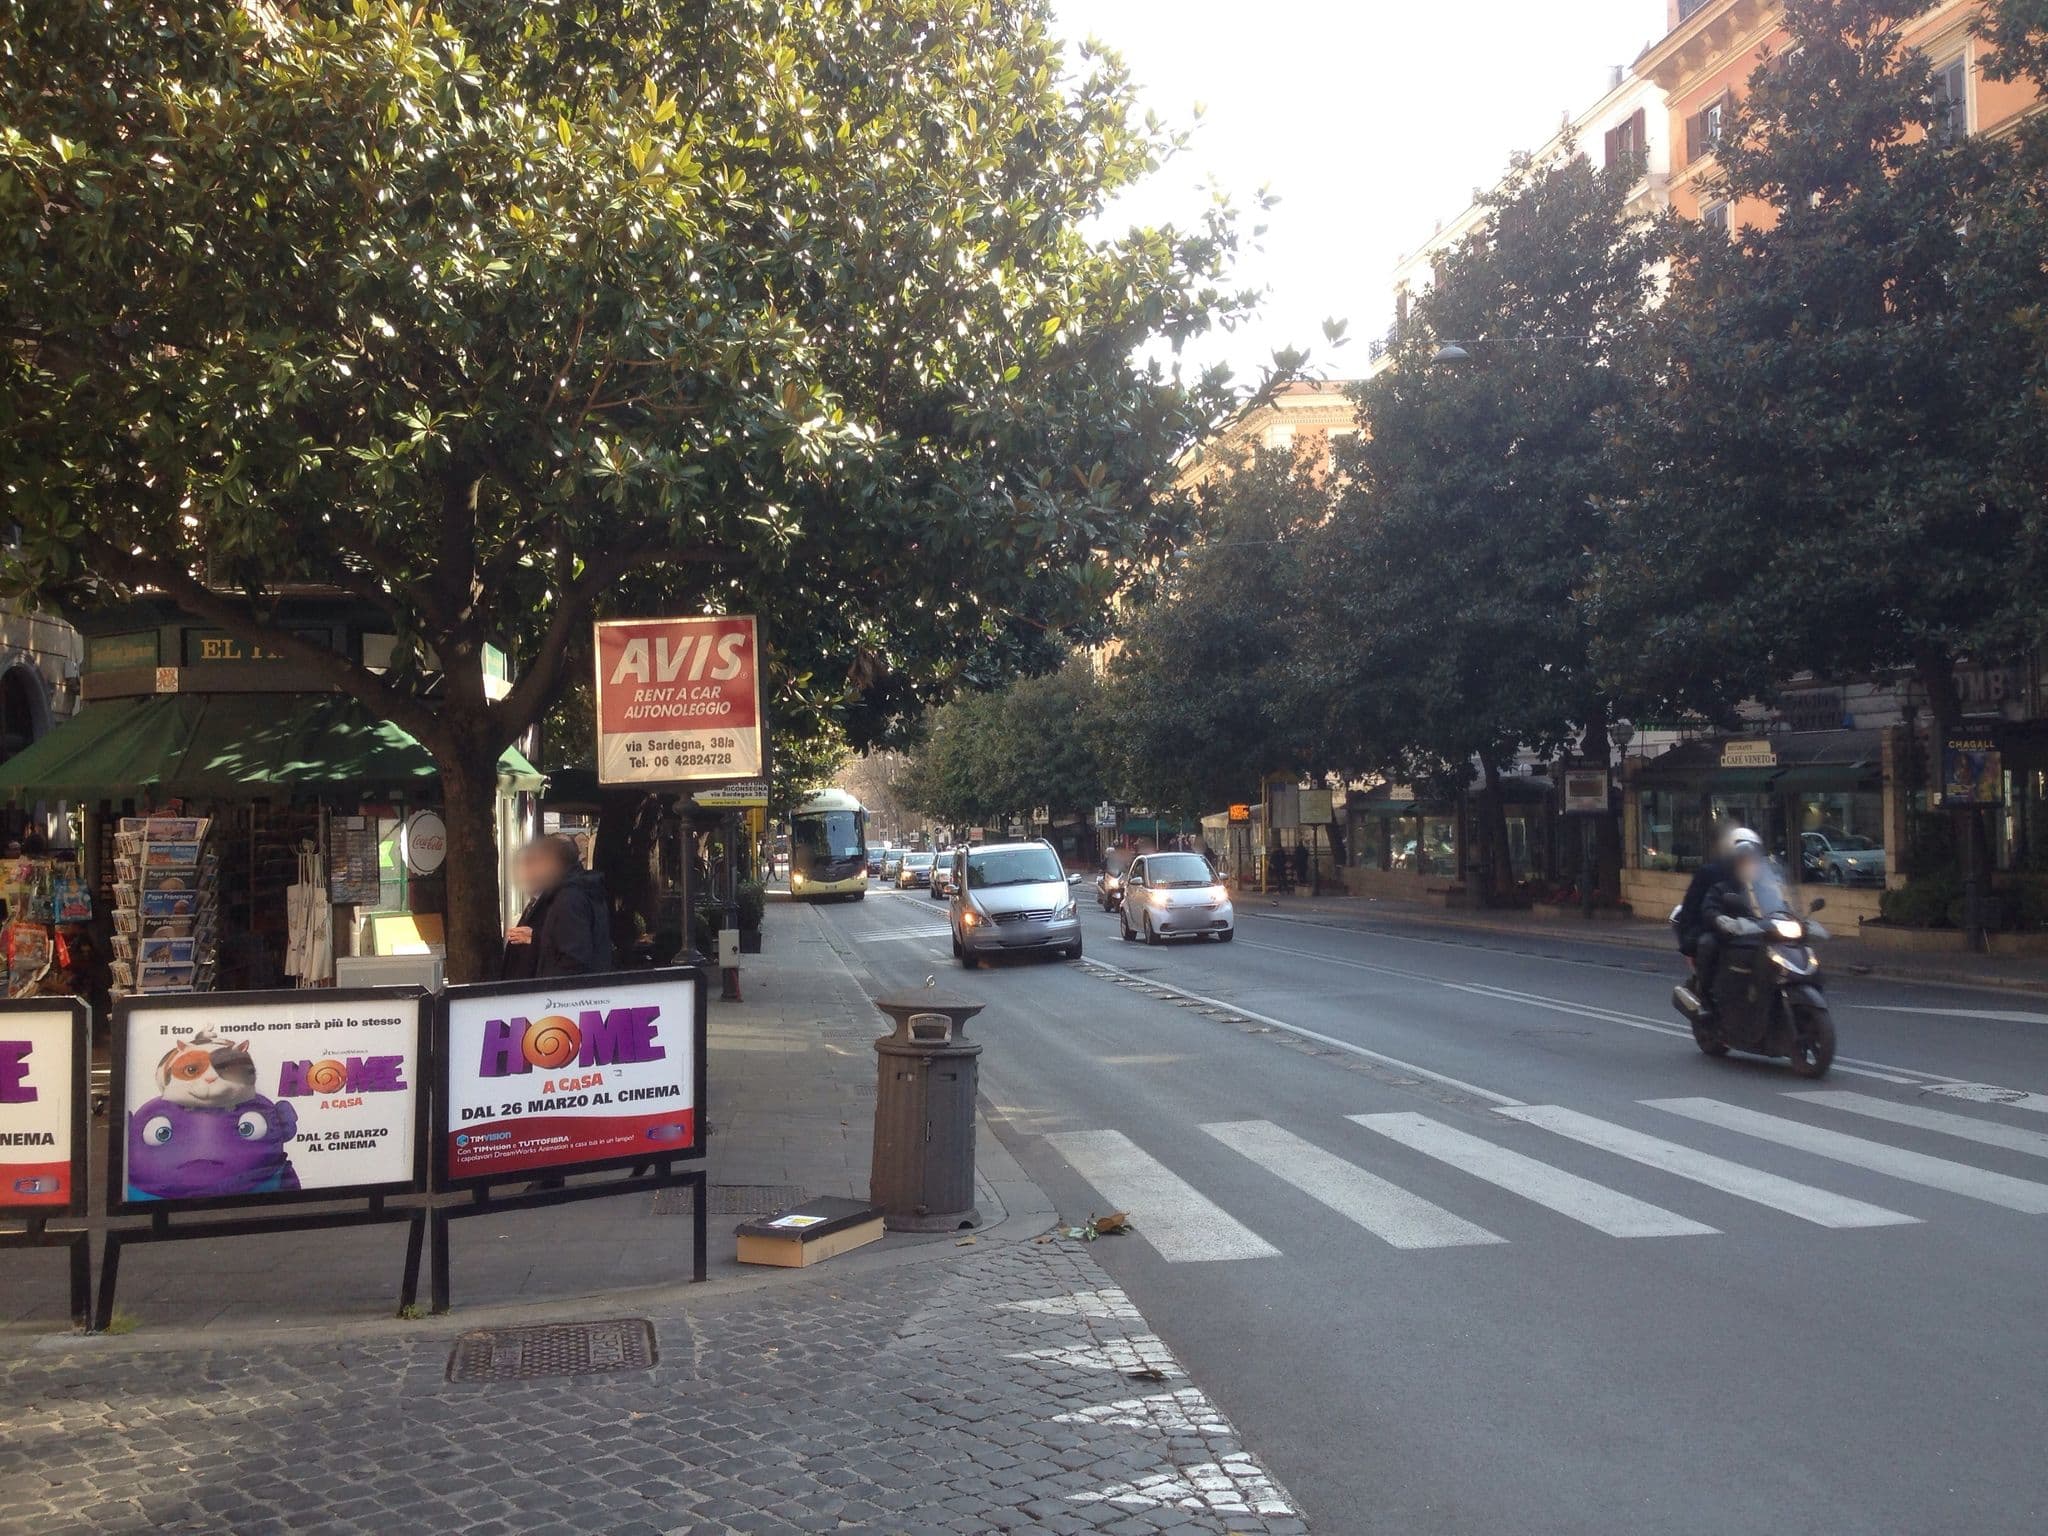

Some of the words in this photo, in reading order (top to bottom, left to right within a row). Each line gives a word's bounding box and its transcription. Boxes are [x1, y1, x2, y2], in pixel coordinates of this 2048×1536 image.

[200, 639, 241, 659] EL
[609, 632, 746, 685] AVIS
[634, 688, 675, 702] RENT
[676, 687, 687, 701] A
[690, 686, 721, 700] CAR
[624, 701, 731, 719] AUTONOLEGGIO
[625, 740, 642, 752] via
[648, 738, 705, 753] Sardegna,
[710, 737, 735, 749] 38/a
[1948, 740, 1996, 749] CHAGALL
[629, 756, 649, 768] Tel.
[654, 756, 669, 767] 06
[675, 753, 732, 766] 42824728
[1744, 754, 1770, 764] VENETO
[412, 835, 442, 850] Coca-Cola
[160, 1025, 170, 1036] il
[171, 1025, 193, 1035] tuo
[220, 1021, 265, 1033] mondo
[268, 1022, 291, 1031] non
[295, 1019, 321, 1031] sarà
[324, 1018, 344, 1032] più
[346, 1017, 358, 1028] lo
[361, 1016, 402, 1028] stesso
[479, 1006, 666, 1078] HOME
[278, 1055, 408, 1097] HOME
[543, 1080, 555, 1094] A
[559, 1072, 603, 1092] CASA
[320, 1097, 329, 1109] A
[332, 1097, 363, 1109] CASA
[461, 1106, 496, 1121] DAL
[501, 1102, 522, 1116] 26
[528, 1094, 588, 1114] MARZO
[592, 1092, 613, 1106] AL
[618, 1085, 680, 1102] CINEMA
[296, 1132, 323, 1143] DAL
[325, 1130, 341, 1141] 26
[344, 1127, 388, 1140] MARZO
[308, 1142, 326, 1153] AL
[328, 1139, 376, 1152] CINEMA
[457, 1147, 471, 1156] Con
[518, 1135, 570, 1147] TUTTOFIBRA
[494, 1147, 536, 1159] DreamWorks
